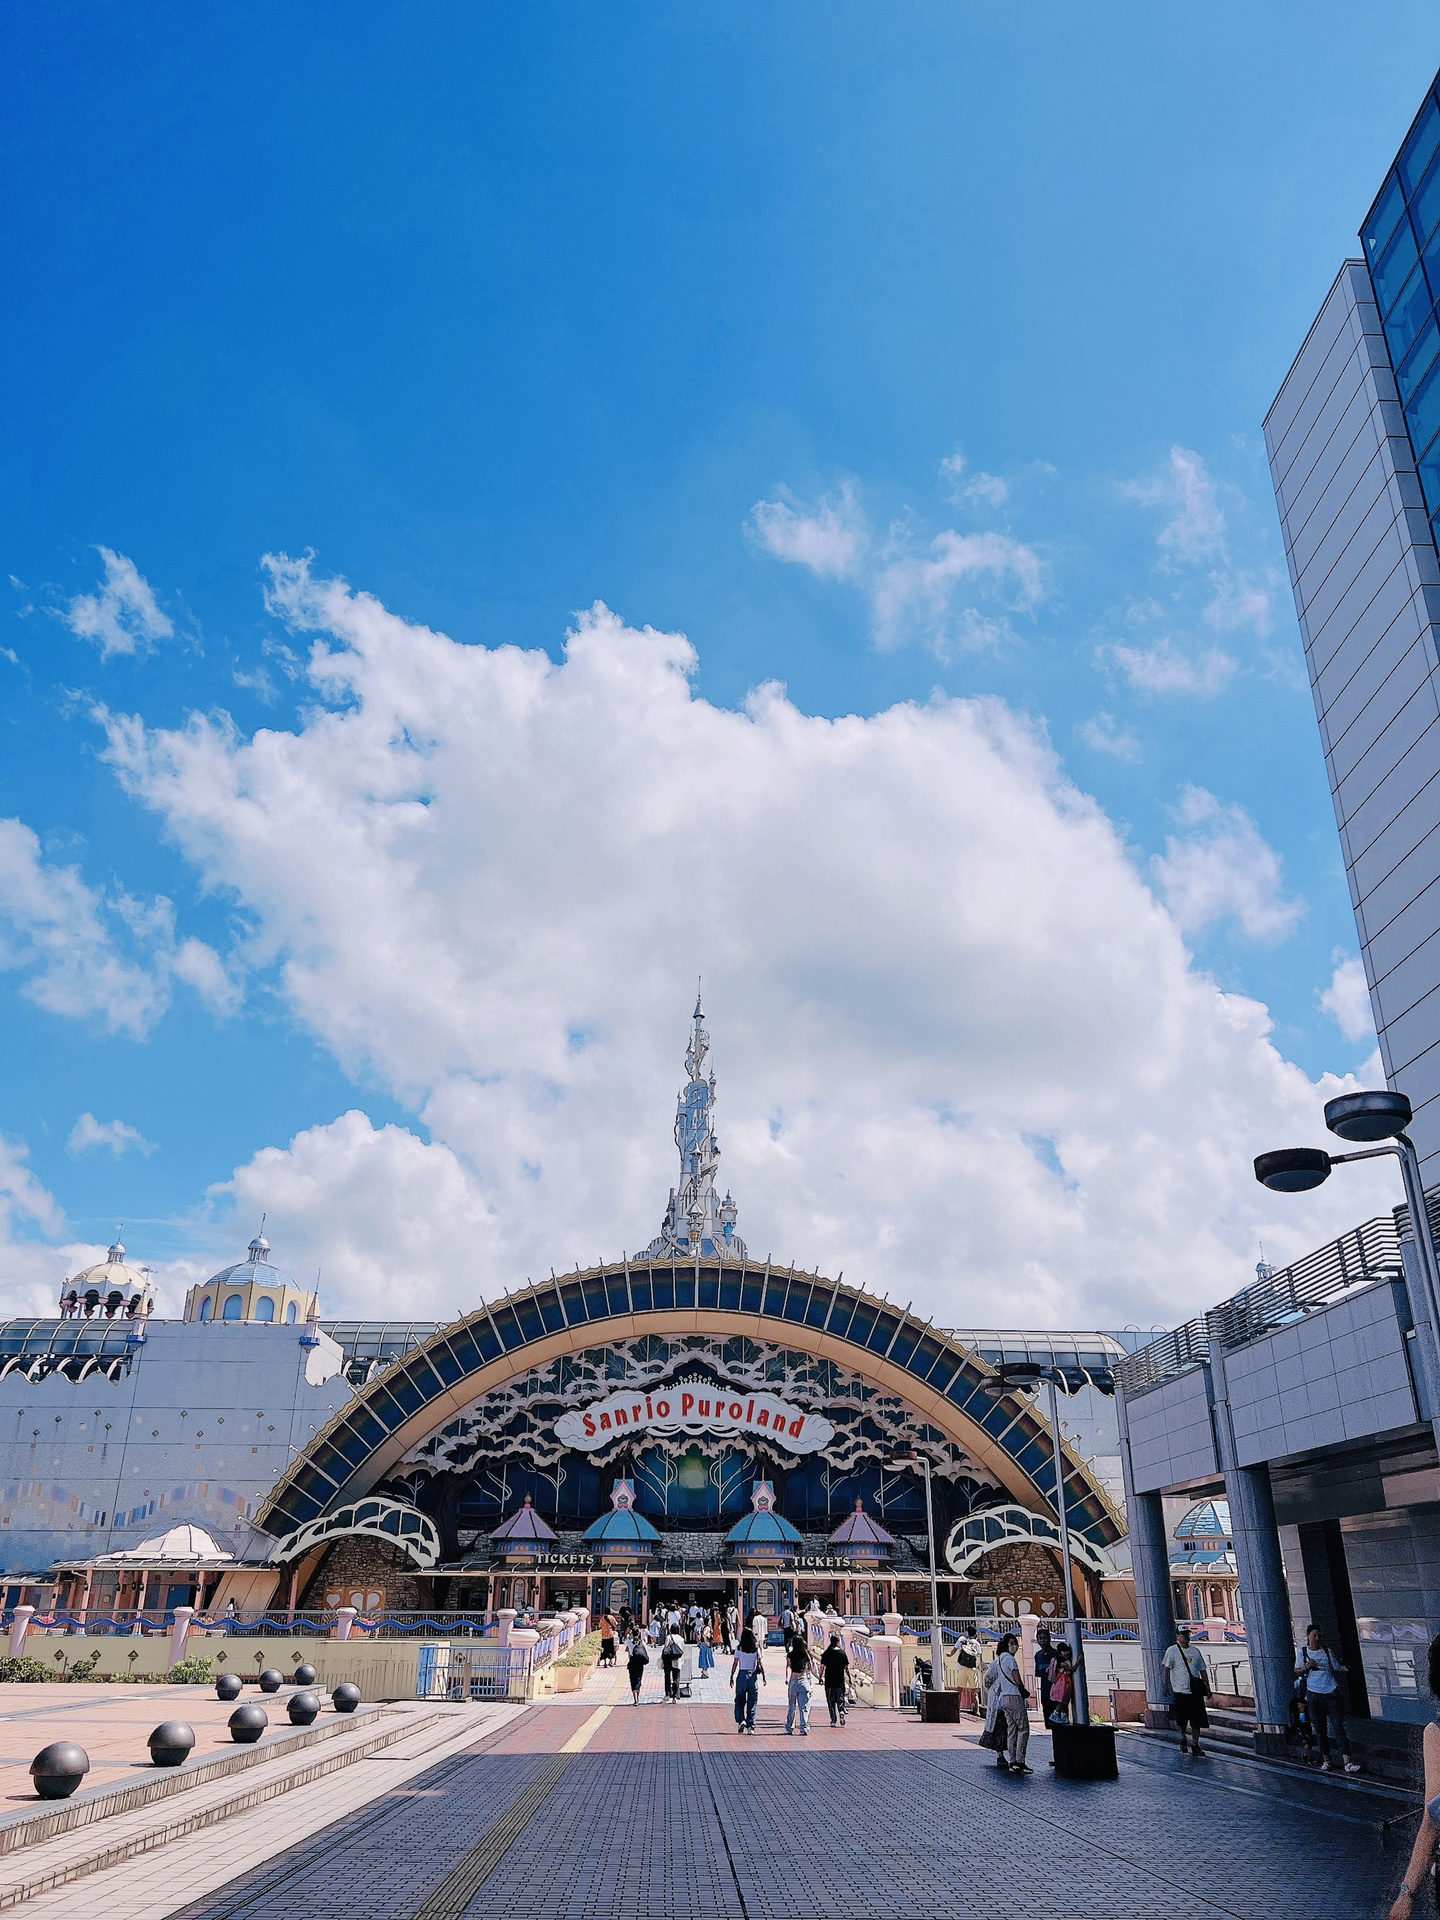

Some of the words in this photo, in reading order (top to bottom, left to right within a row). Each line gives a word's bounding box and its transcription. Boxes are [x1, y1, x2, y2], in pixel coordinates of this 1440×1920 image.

[582, 1396, 671, 1438] Sanrio
[681, 1393, 806, 1439] Puroland
[536, 1553, 595, 1564] TICKETS
[793, 1556, 851, 1567] TICKETS
